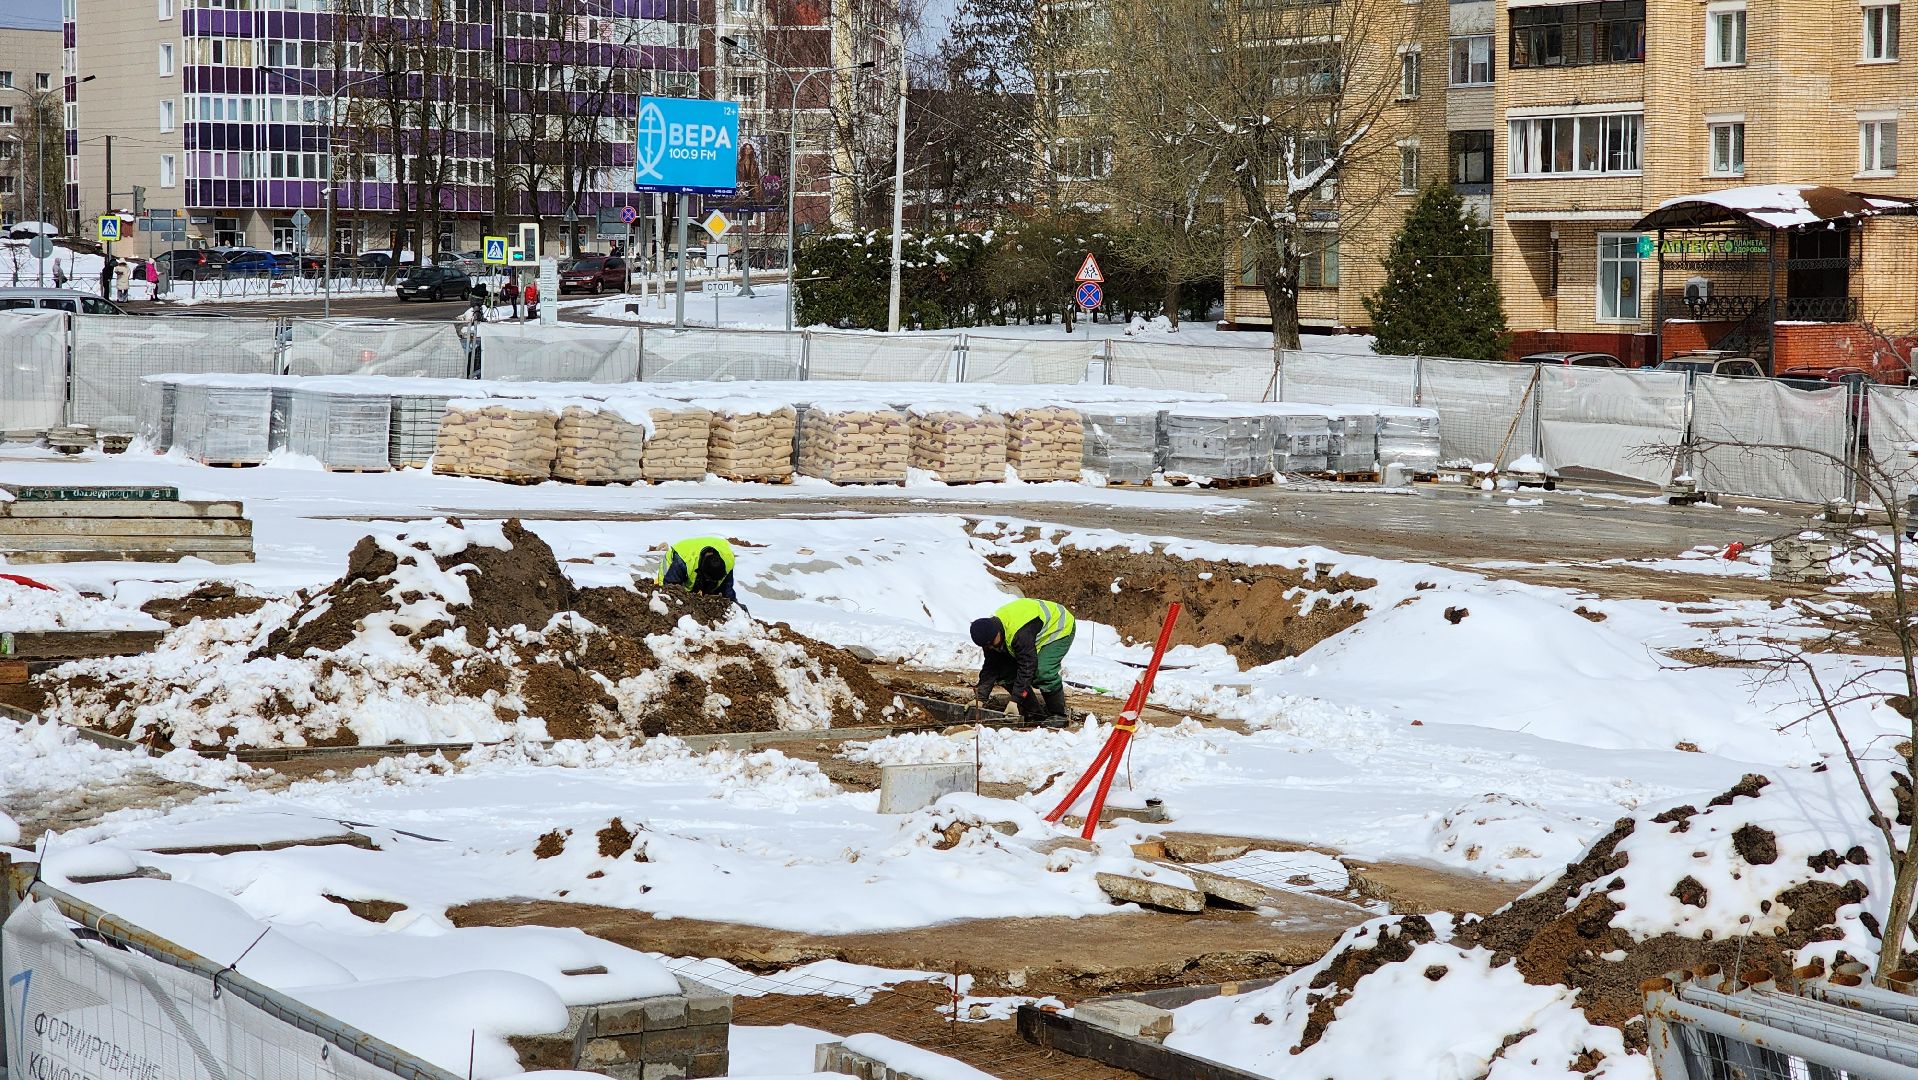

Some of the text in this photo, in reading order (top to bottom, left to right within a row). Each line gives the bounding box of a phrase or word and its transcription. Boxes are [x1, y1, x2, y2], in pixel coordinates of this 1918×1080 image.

[668, 122, 732, 149] ВЕРА
[668, 148, 717, 161] 100.9 FM
[1660, 239, 1721, 254] АПТЕКА
[1733, 239, 1764, 247] ПЛАНЕТА
[1733, 246, 1767, 254] ЗДОРОВЬЯ
[34, 1012, 162, 1080] ФОРМИРОВАНИЕ
